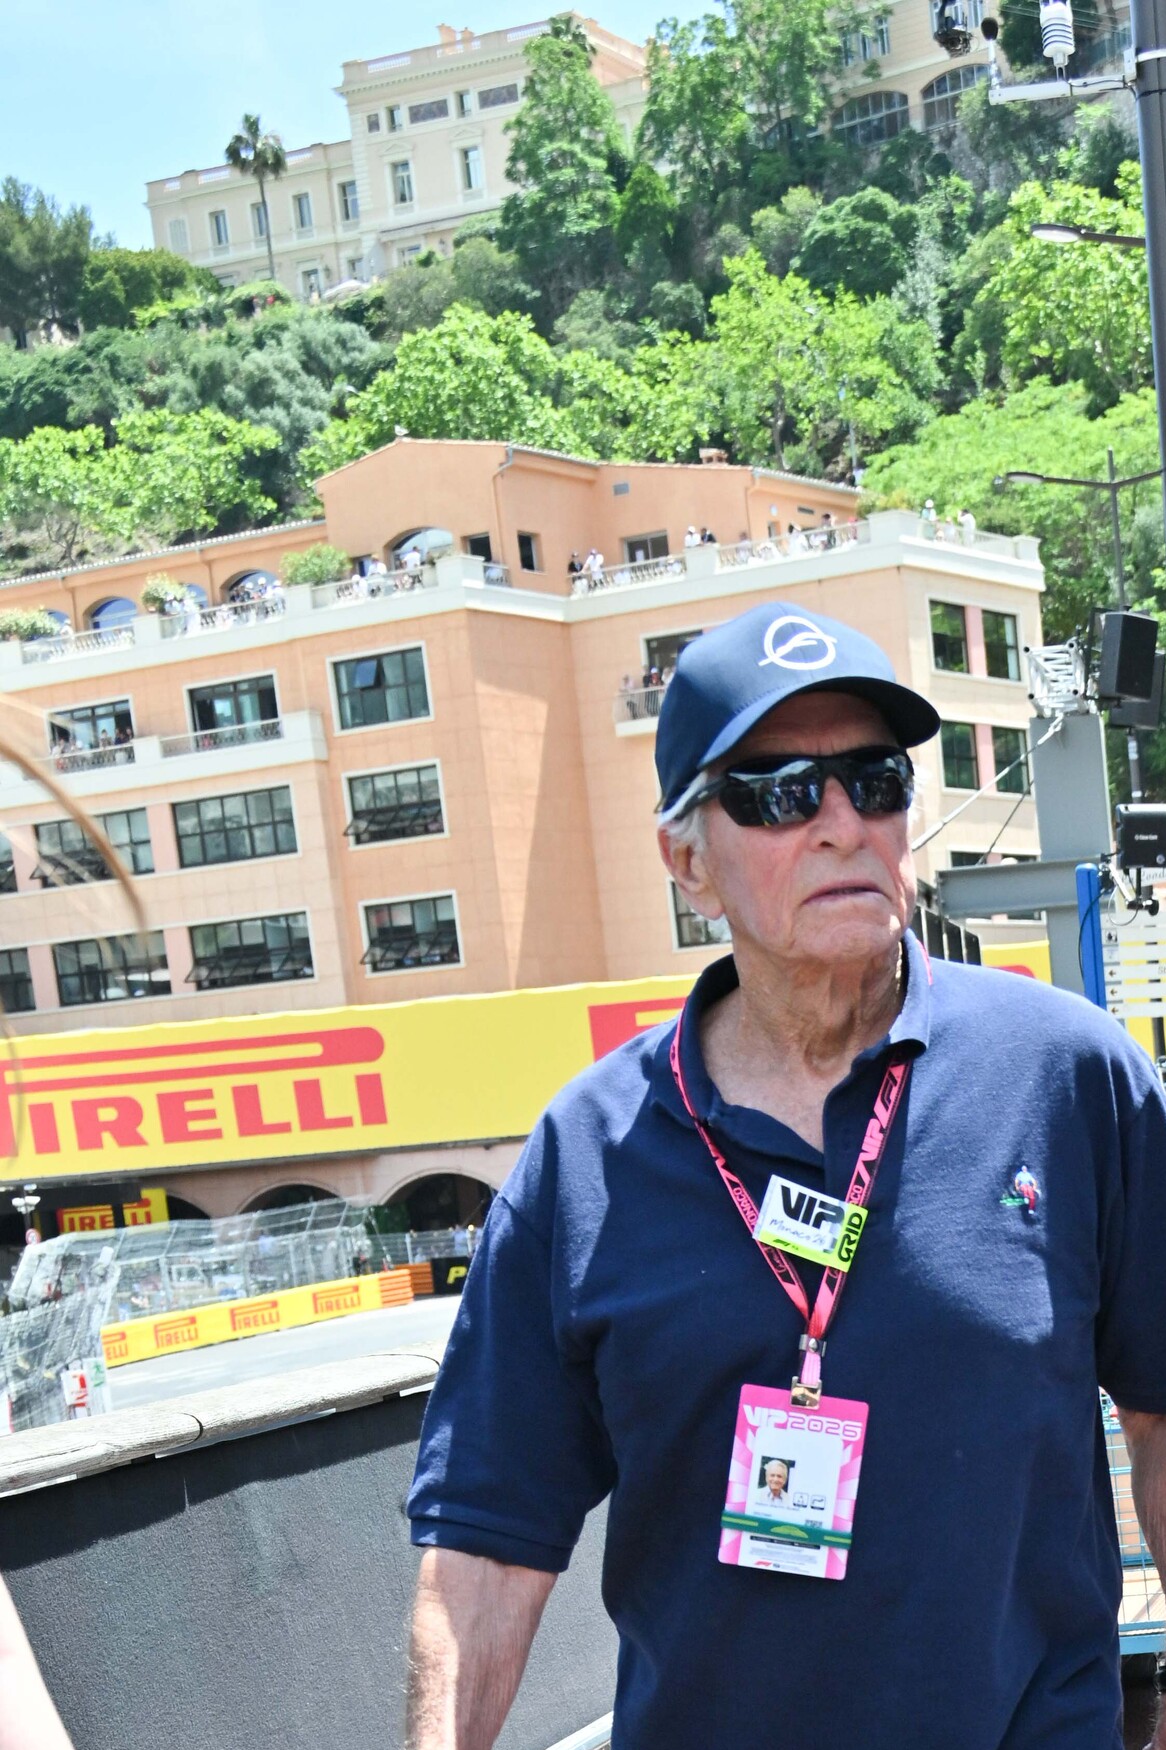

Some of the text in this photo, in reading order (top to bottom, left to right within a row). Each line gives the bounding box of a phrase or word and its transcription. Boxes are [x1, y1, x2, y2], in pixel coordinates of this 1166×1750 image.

[56, 1197, 152, 1234] PIRELI
[781, 1184, 845, 1230] VIP
[838, 1212, 863, 1263] GRID
[229, 1299, 281, 1333] PIRELLI
[312, 1284, 362, 1316] PIRELLI
[153, 1315, 199, 1350] PIRELLI
